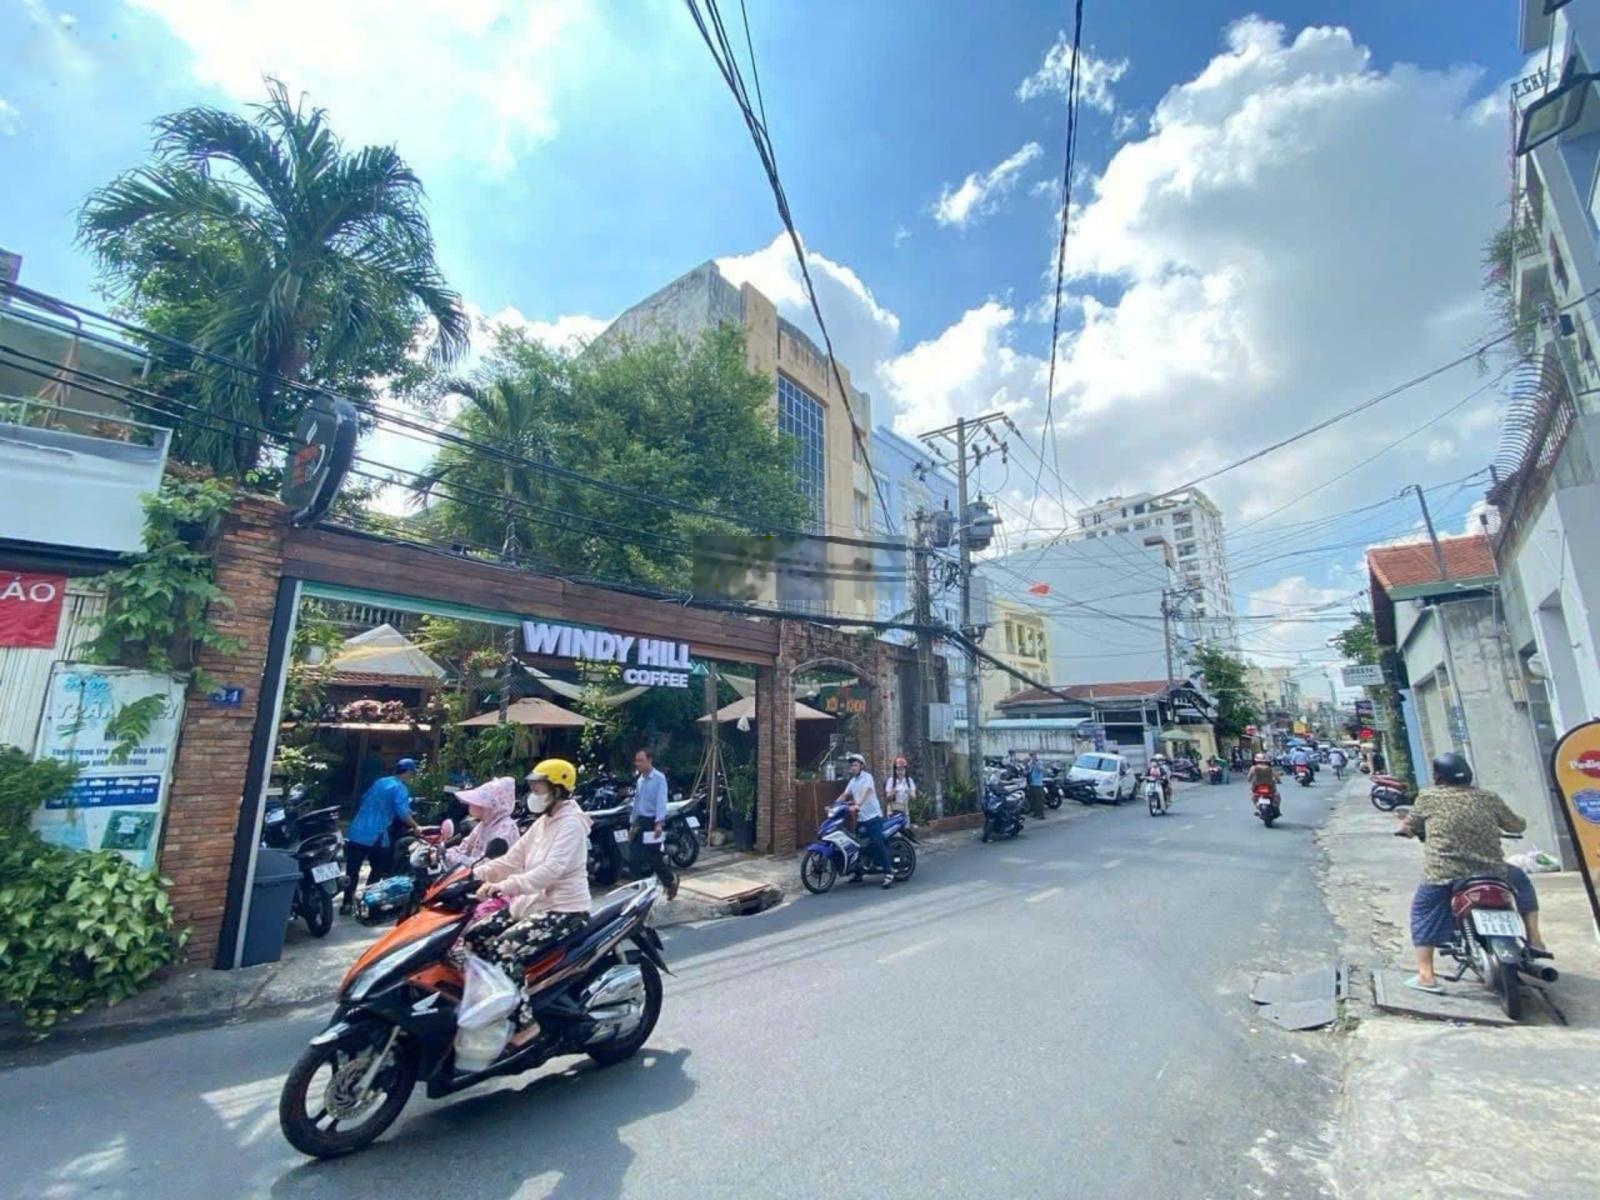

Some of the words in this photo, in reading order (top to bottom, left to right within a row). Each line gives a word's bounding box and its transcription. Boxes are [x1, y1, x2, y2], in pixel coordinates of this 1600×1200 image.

[0, 576, 55, 602] ÁO
[522, 621, 635, 663] WINDY
[638, 638, 691, 670] HILL
[623, 668, 689, 689] COFFEE
